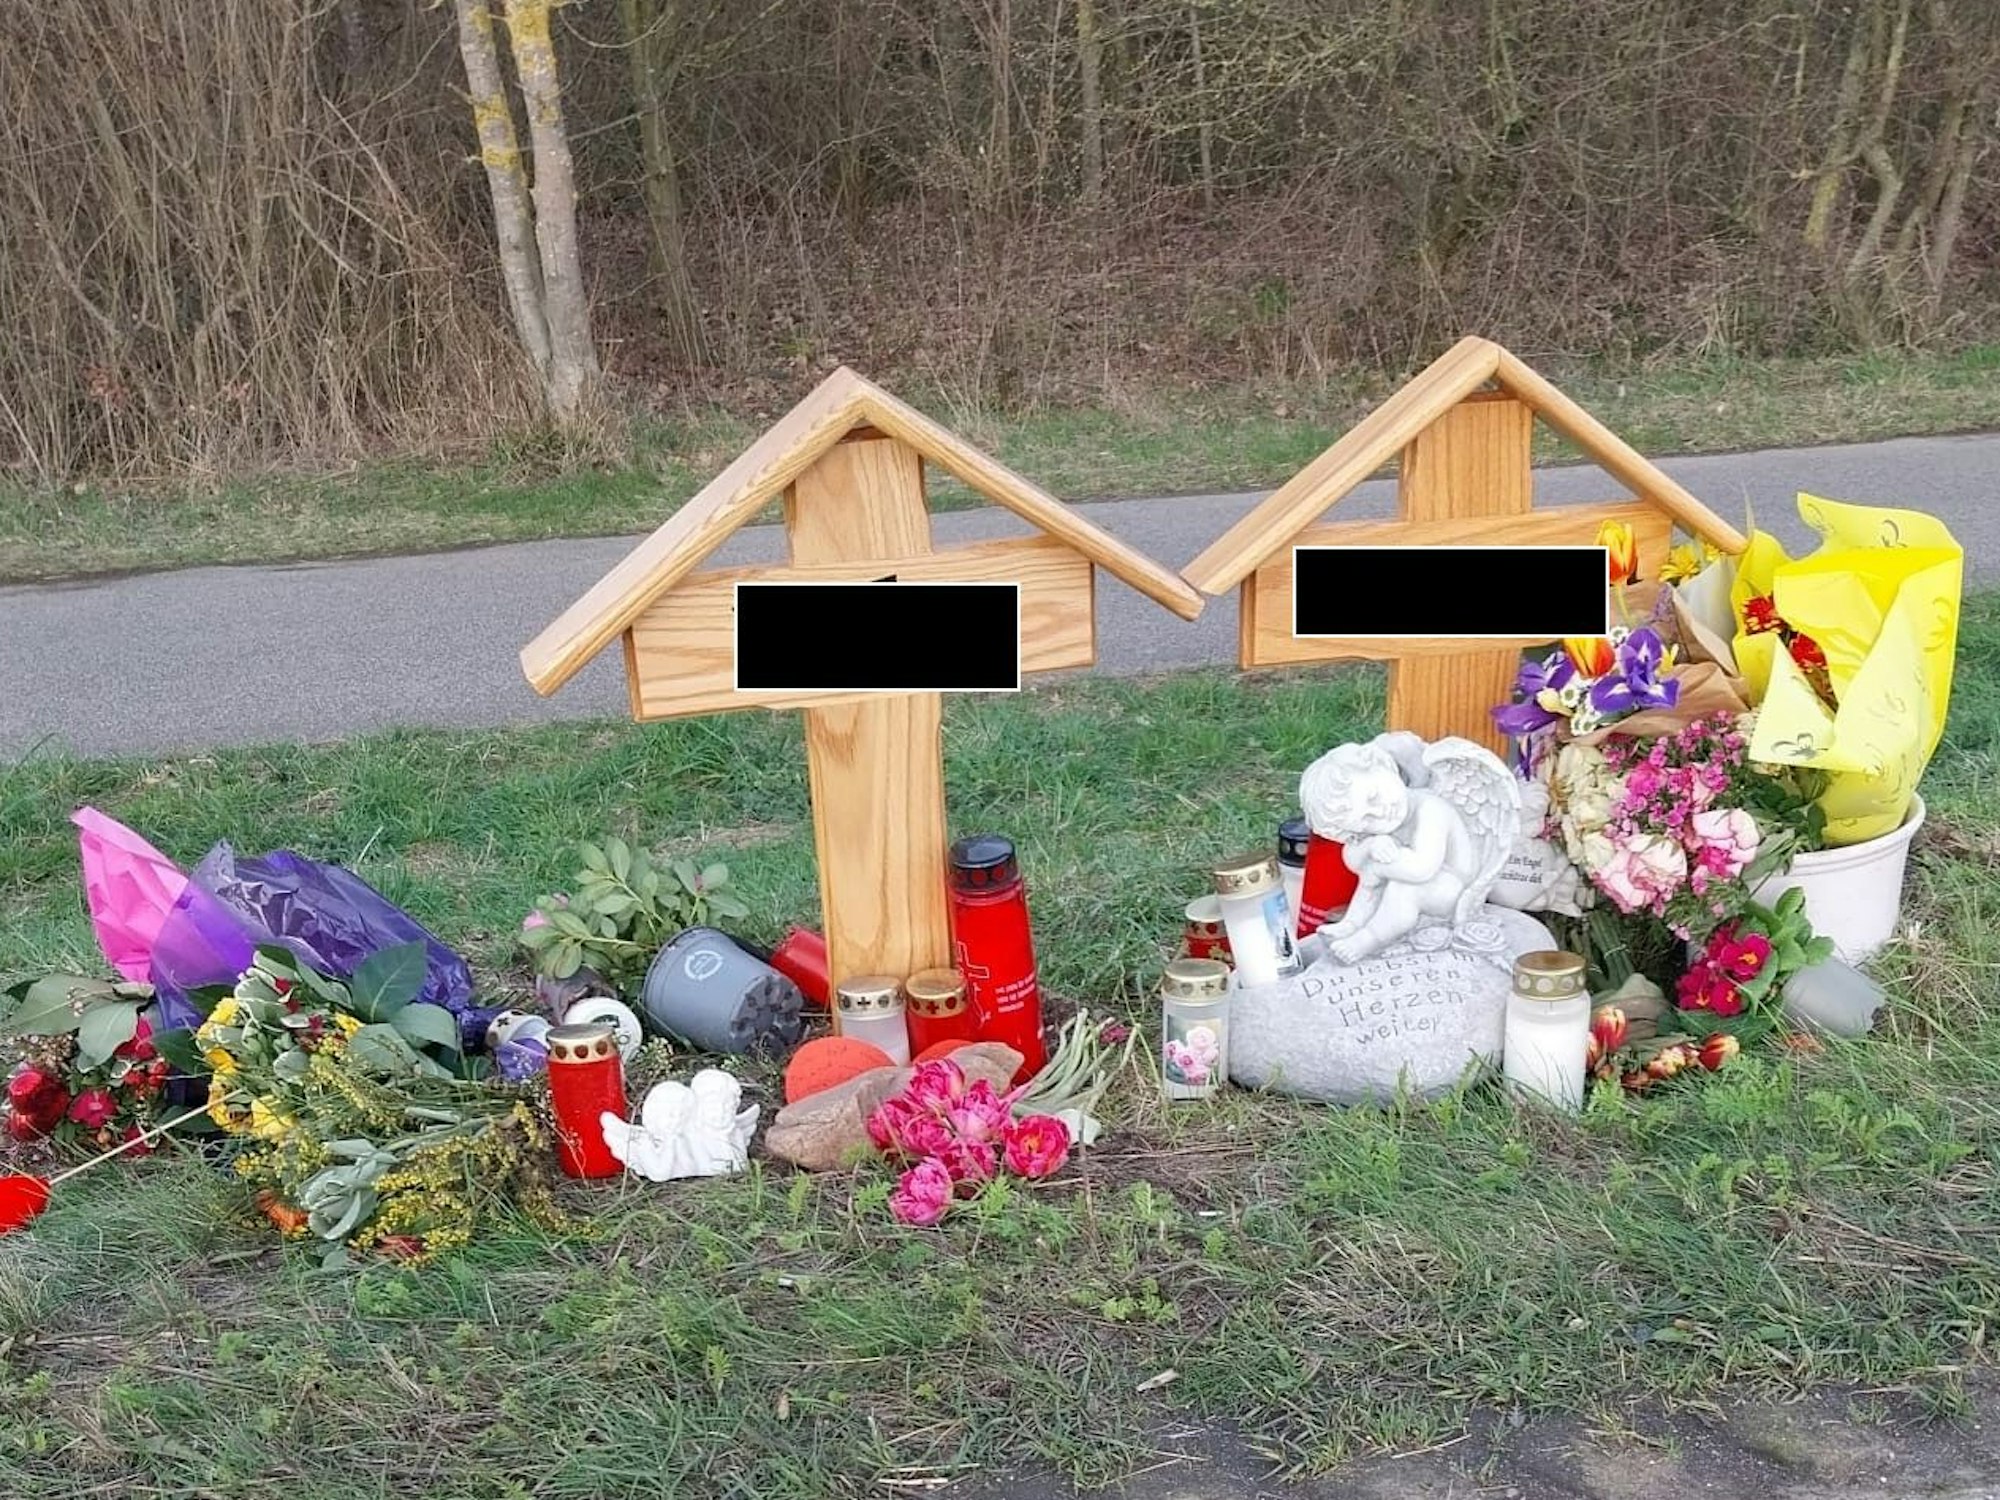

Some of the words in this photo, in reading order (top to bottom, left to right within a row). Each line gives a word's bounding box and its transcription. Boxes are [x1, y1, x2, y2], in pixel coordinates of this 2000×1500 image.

[1302, 975, 1346, 999] Du
[1358, 952, 1437, 977] lebst
[1327, 968, 1461, 1005] unseren
[1339, 989, 1464, 1027] Herzen
[1356, 1013, 1441, 1045] weiter
